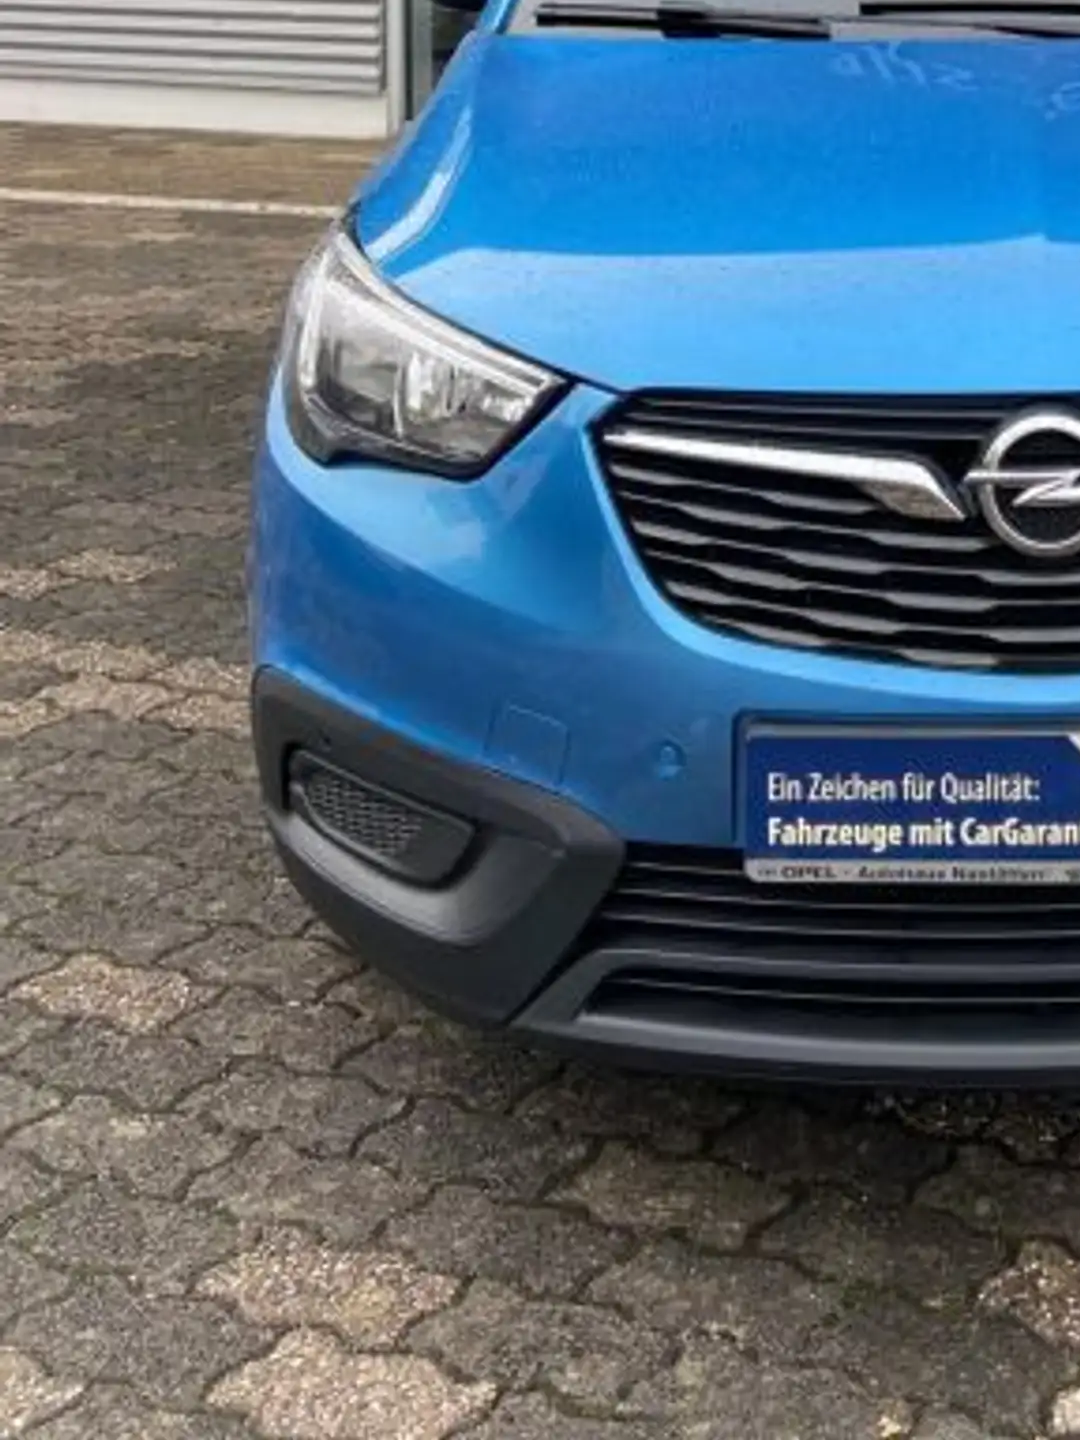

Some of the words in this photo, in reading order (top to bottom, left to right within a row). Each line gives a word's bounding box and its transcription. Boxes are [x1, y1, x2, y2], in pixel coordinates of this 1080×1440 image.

[767, 773, 801, 801] Ein
[808, 773, 897, 802] Zeichen
[902, 772, 935, 801] für
[940, 771, 1041, 804] Qualität:
[767, 816, 902, 853] Fahrzeuge
[908, 816, 955, 845] mit
